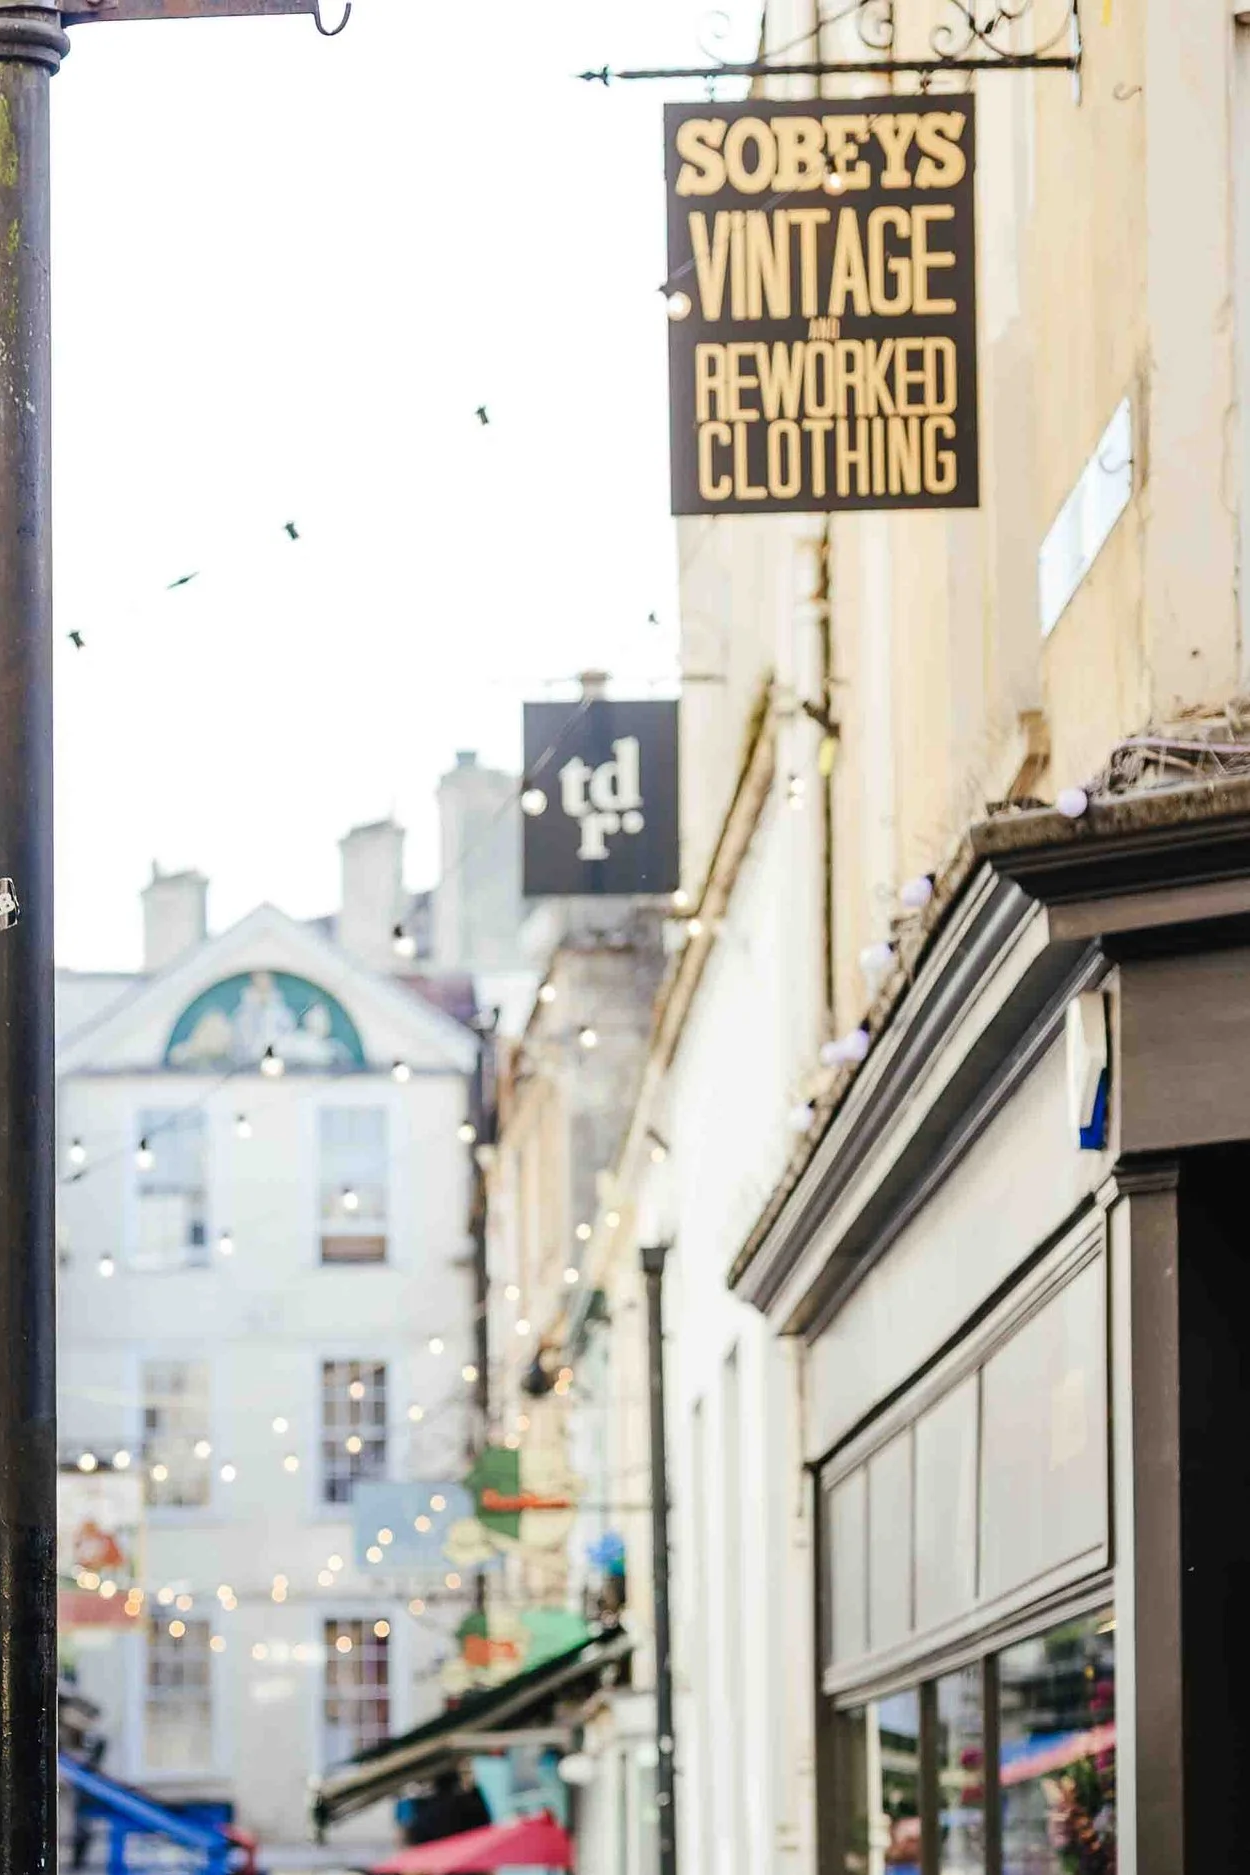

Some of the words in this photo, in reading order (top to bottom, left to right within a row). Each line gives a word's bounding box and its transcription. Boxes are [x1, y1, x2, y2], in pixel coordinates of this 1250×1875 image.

[675, 111, 966, 196] SOBEYS
[689, 204, 956, 321] VINTAGE
[695, 336, 957, 423] REWORKED
[697, 415, 957, 500] CLOTHING
